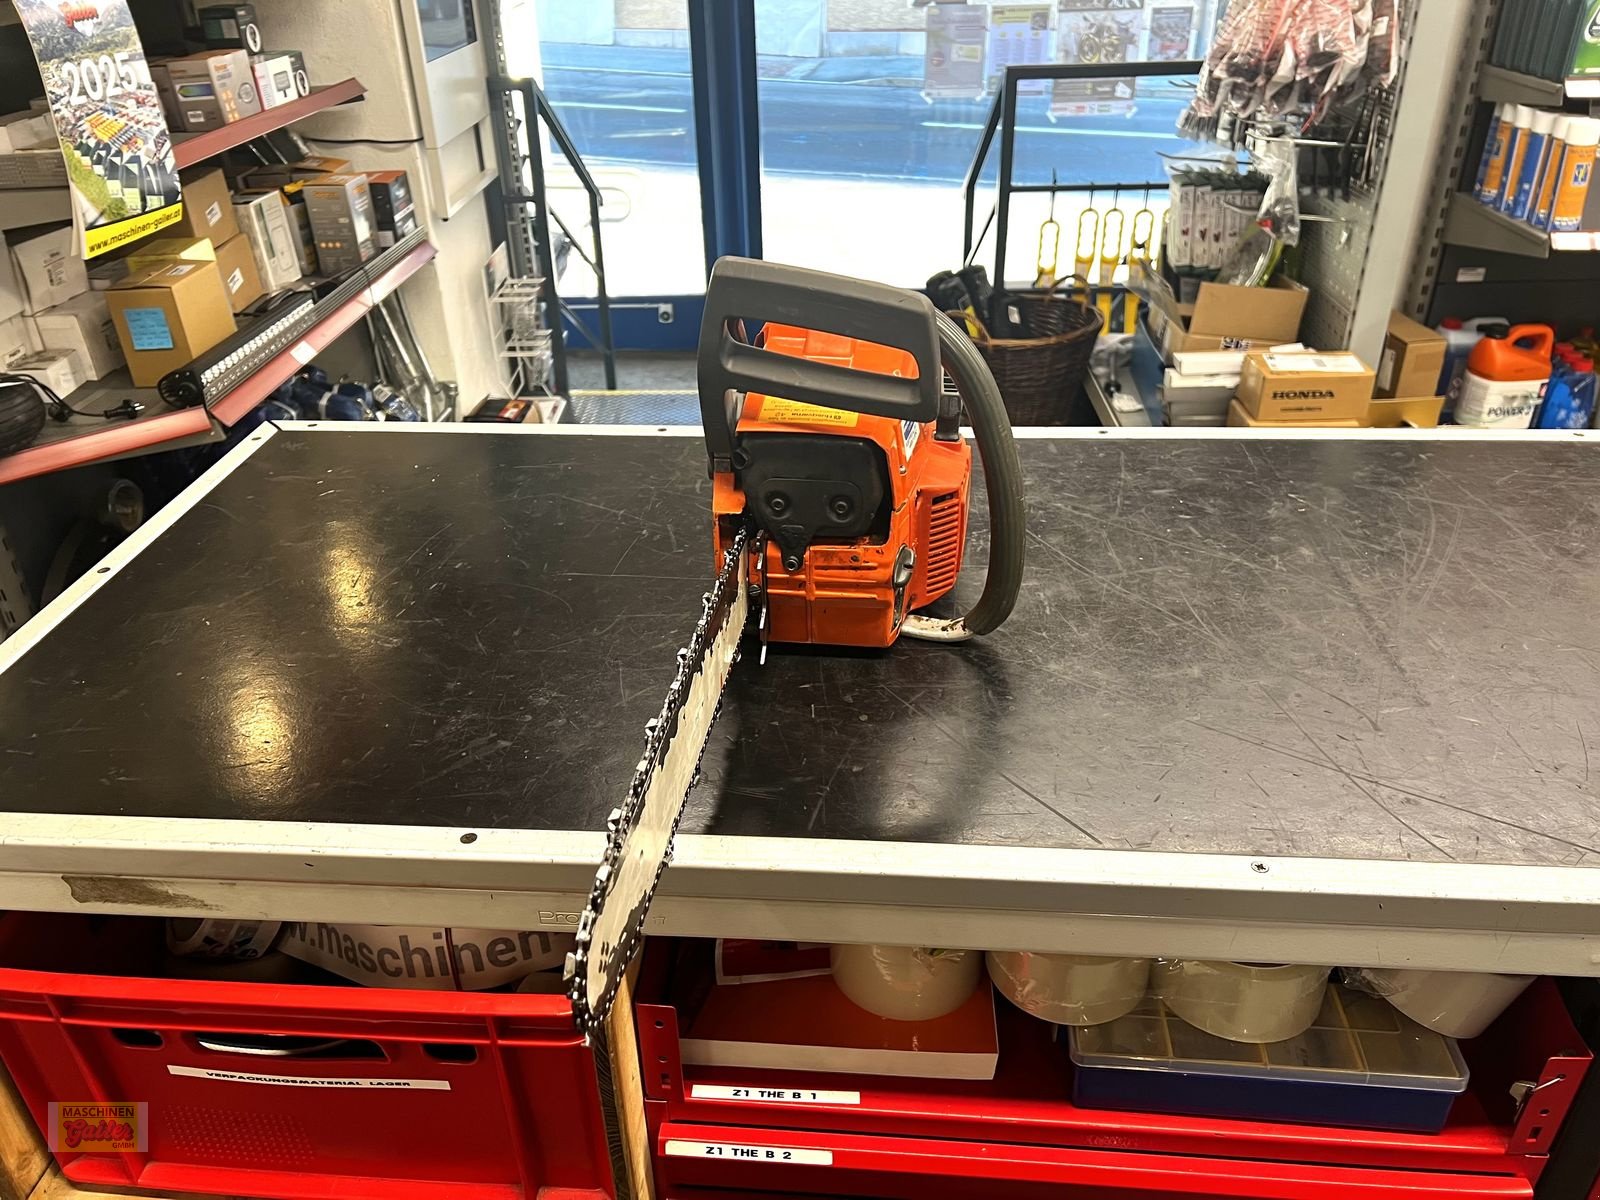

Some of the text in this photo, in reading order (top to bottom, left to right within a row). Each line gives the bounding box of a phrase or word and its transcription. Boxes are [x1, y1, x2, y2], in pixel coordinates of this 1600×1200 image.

[61, 52, 137, 105] 2025
[89, 209, 181, 252] www.maschinen-gailer.at
[1272, 390, 1335, 399] HONDA
[1487, 406, 1524, 417] POWER
[206, 1071, 362, 1086] VERPACKUNGSMATERIAL
[732, 1089, 817, 1100] Z1 THE B 1
[705, 1146, 792, 1160] Z1 THE B 2
